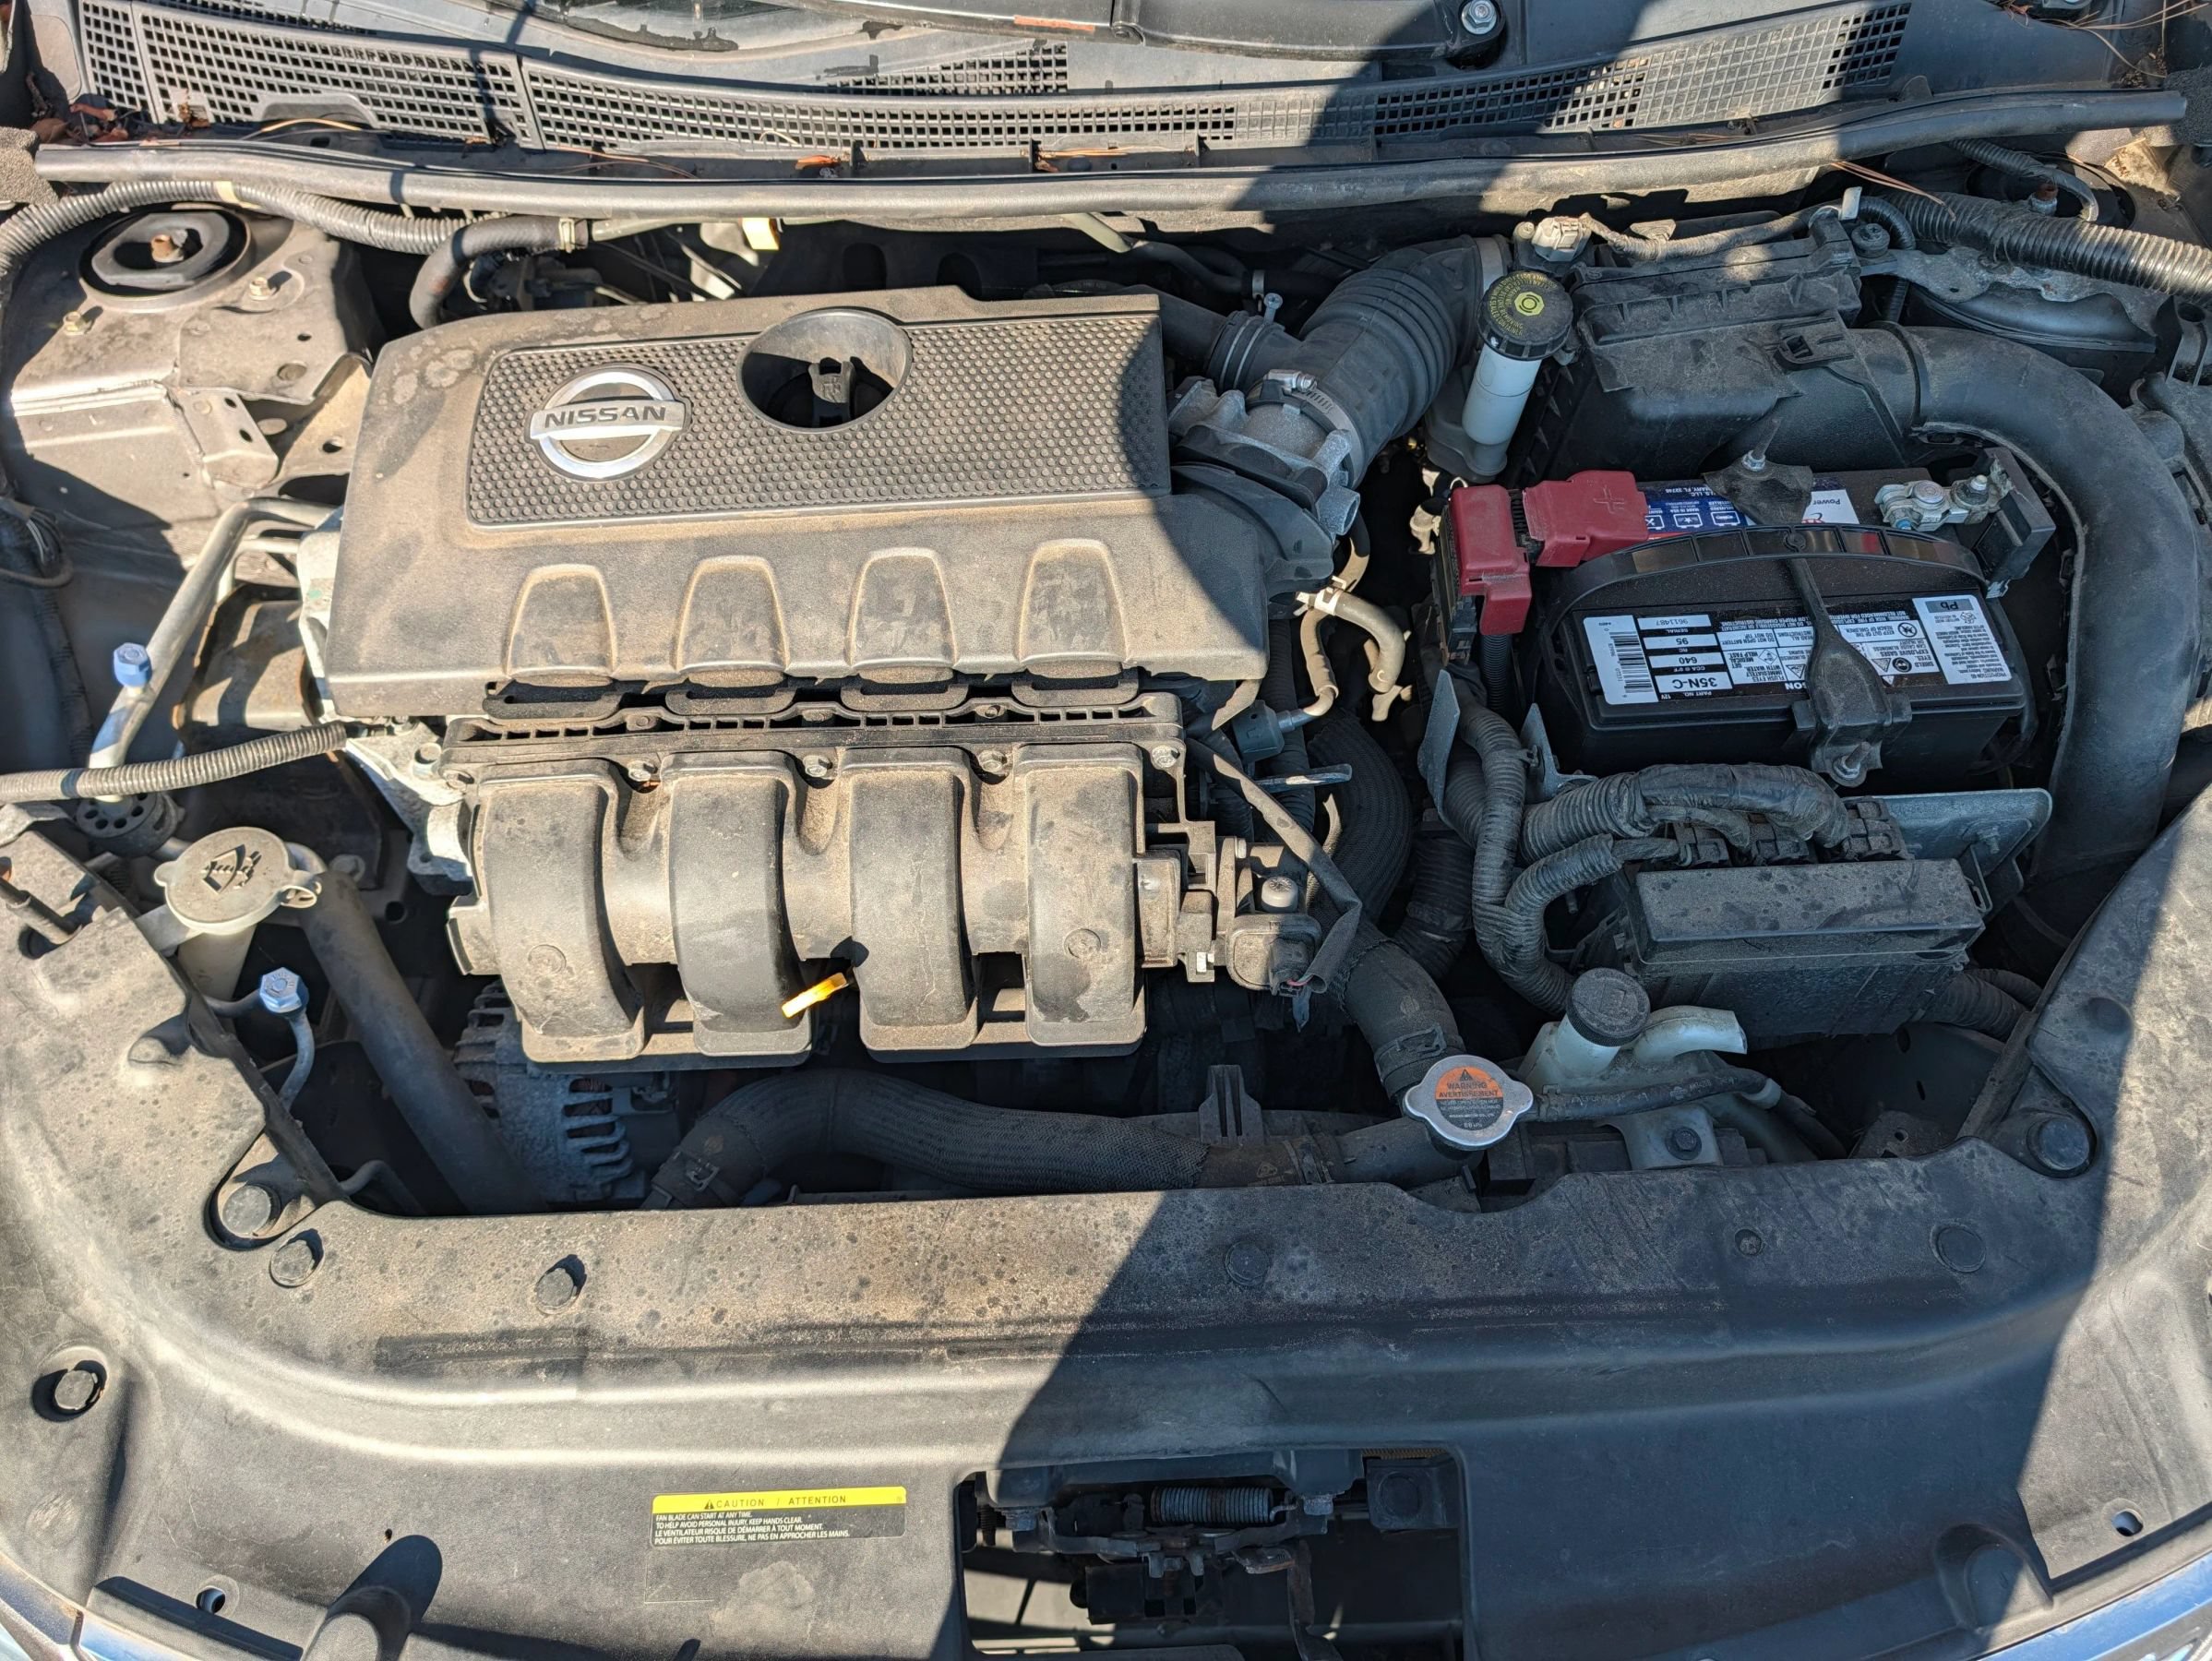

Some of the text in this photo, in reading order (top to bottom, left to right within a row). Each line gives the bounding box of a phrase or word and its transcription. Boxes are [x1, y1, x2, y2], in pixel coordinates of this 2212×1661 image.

[544, 406, 665, 428] NISSAN
[1941, 601, 1959, 610] Pb
[1672, 678, 1718, 689] 35N-C
[1447, 1081, 1487, 1089] WARNING
[716, 1499, 764, 1508] CAUTION
[788, 1496, 846, 1505] ATTENTION
[673, 1536, 694, 1544] ÉVITER
[779, 1531, 816, 1539] APPROCHER
